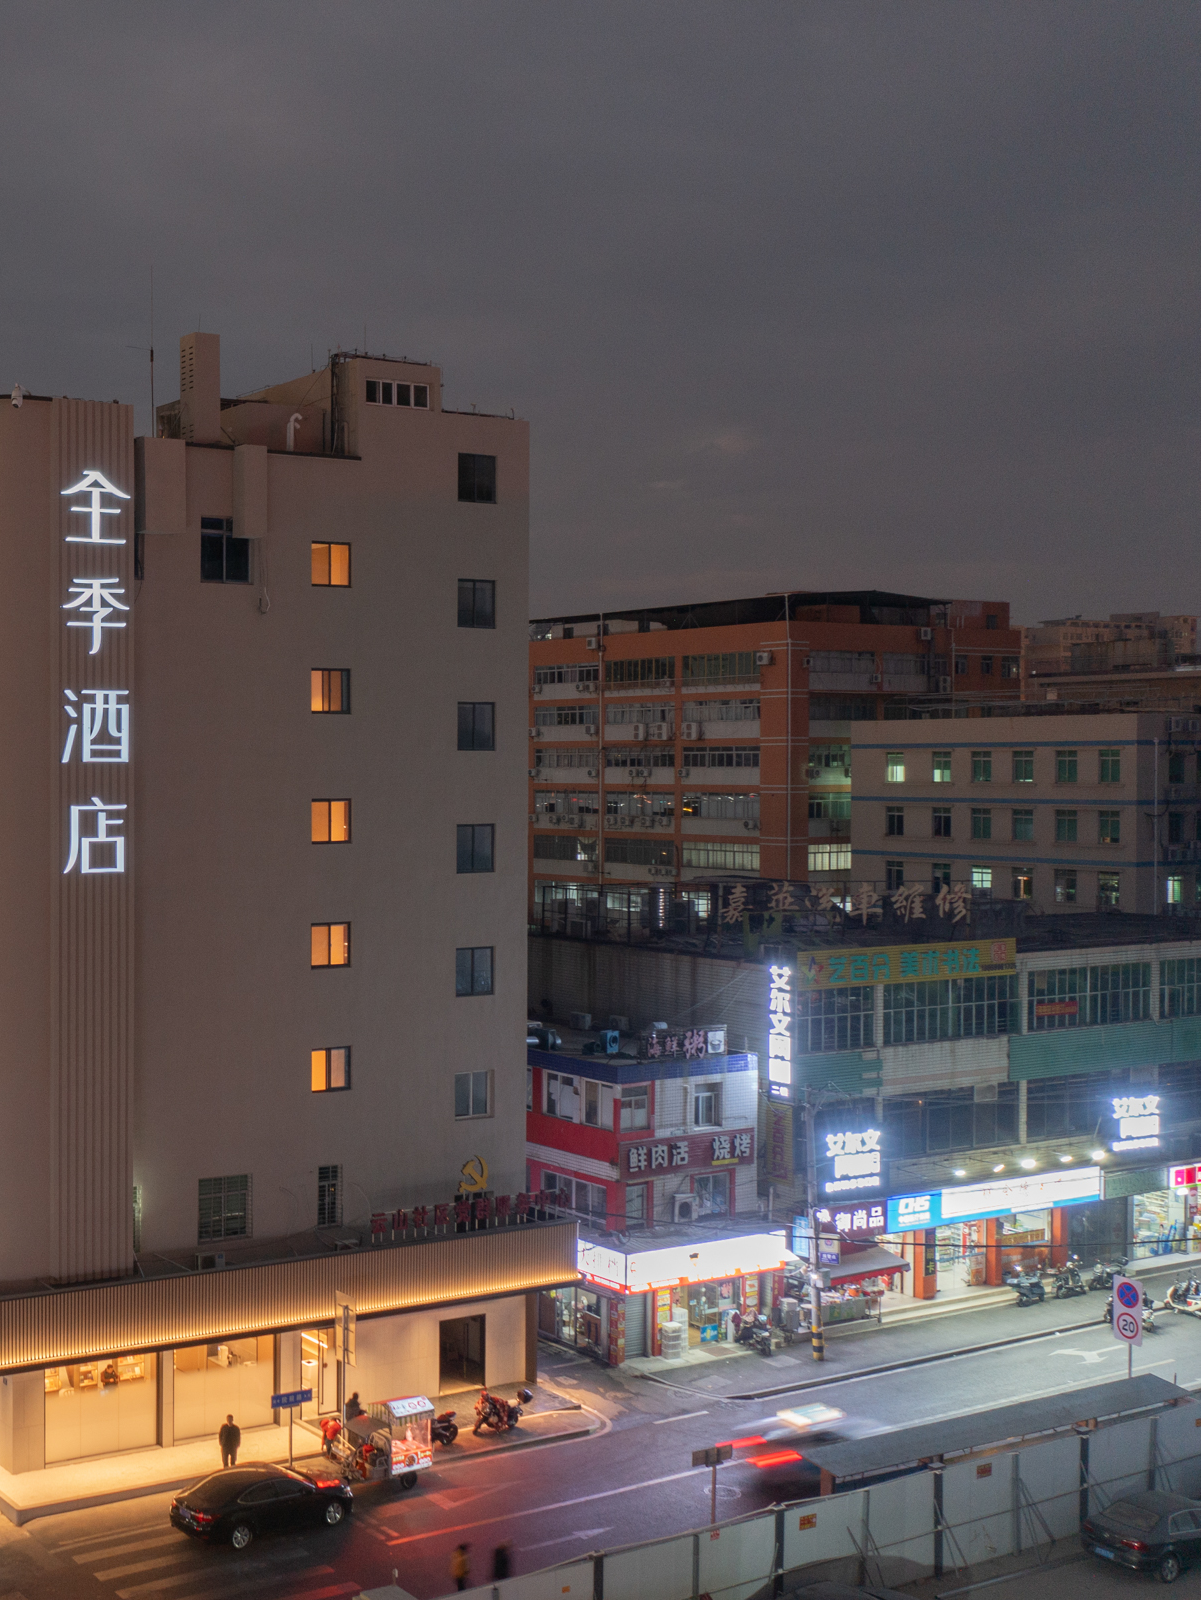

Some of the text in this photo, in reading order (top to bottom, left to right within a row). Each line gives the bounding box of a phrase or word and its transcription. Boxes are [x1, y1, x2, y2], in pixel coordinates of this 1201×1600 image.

[59, 470, 131, 875] 全季酒店
[828, 953, 891, 983] 艺百分
[900, 947, 980, 977] 美术书法
[647, 1029, 706, 1060] 海鲜粥
[628, 1133, 751, 1172] 鲜肉活 烧烤
[370, 1187, 571, 1235] 云山社区党群服务中心
[1121, 1319, 1136, 1333] 20
